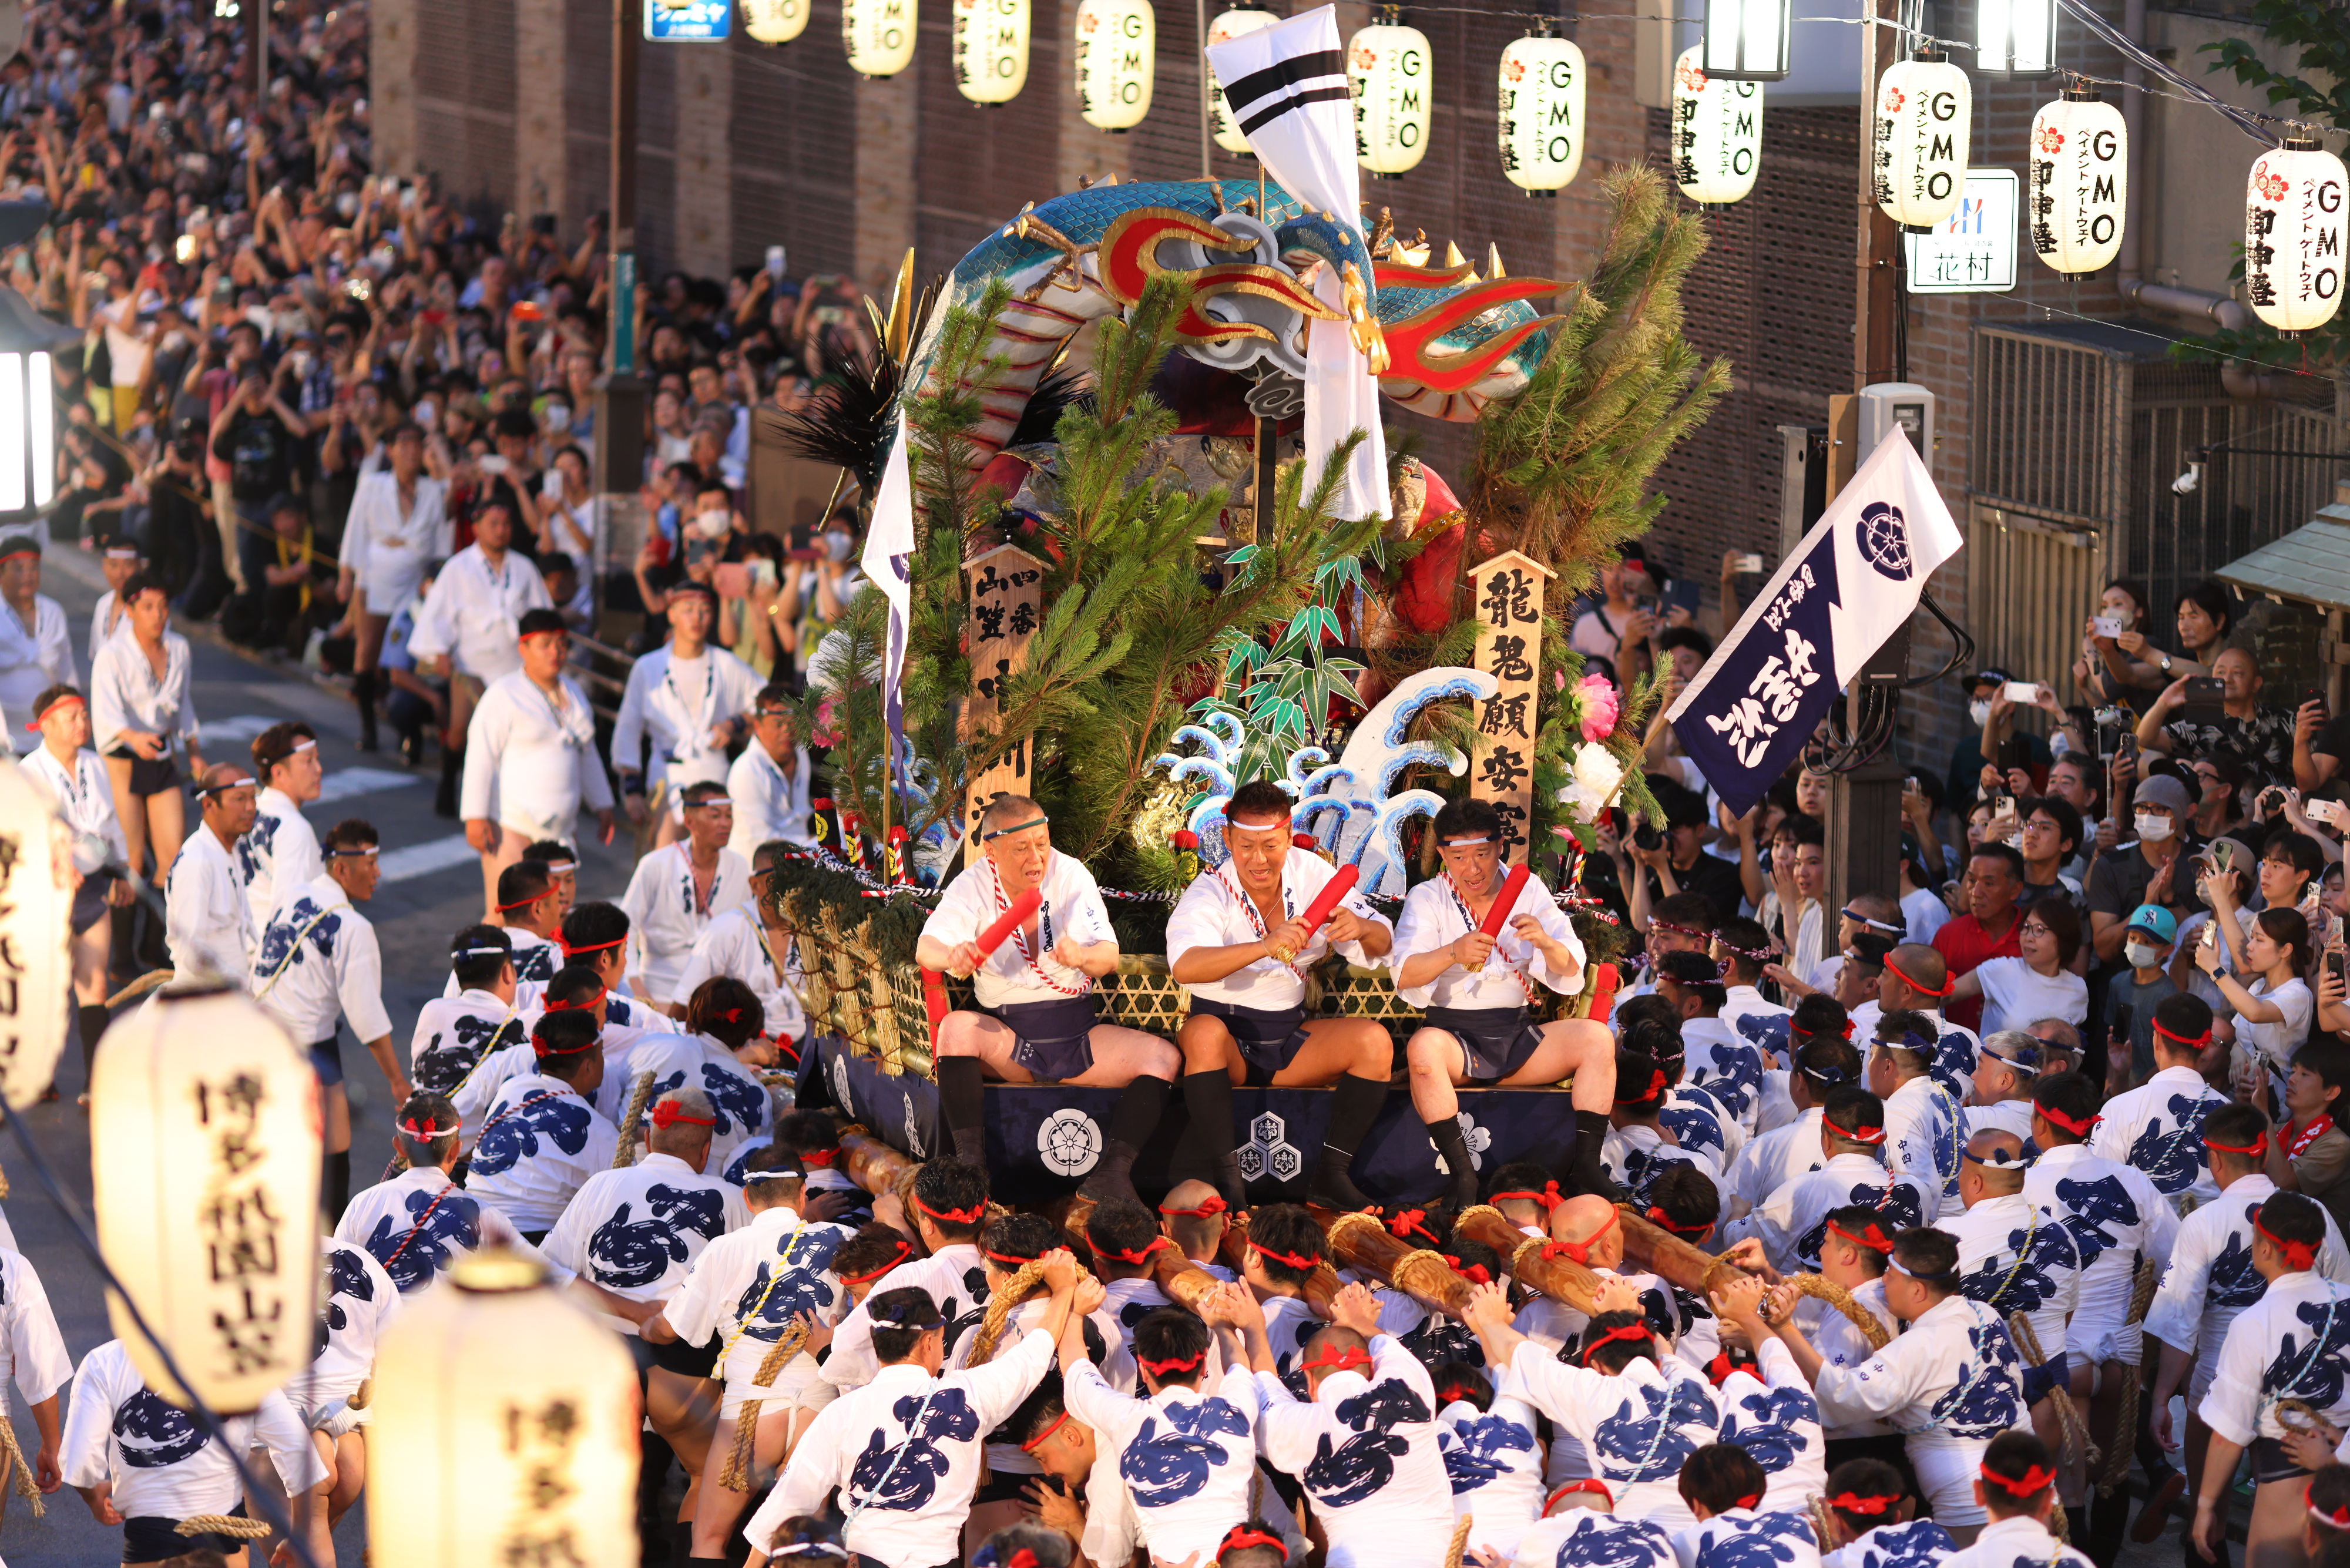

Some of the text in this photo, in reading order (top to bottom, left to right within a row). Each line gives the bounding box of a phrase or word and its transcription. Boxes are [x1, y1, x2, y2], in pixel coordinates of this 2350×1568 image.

[998, 0, 1017, 78] GMO
[1121, 15, 1143, 104] GMO
[1400, 51, 1421, 147] GMO
[1549, 61, 1572, 163] GMO
[1733, 80, 1755, 175] GMO
[1912, 89, 1929, 201] ペイメントゲートウェイ
[1928, 92, 1956, 200] GMO
[2075, 128, 2091, 247] ペイメントゲートウェイ
[2091, 130, 2117, 244] GMO
[1934, 251, 1994, 281] 花村
[2298, 178, 2316, 302] ペイメントゲートウェイ
[2315, 180, 2341, 300] GMO
[975, 566, 1009, 643] 山笠
[1009, 569, 1039, 636] 四番
[1705, 628, 1821, 768] 中洲流
[1898, 1139, 1912, 1164] 中四
[1860, 1364, 1884, 1381] 中四
